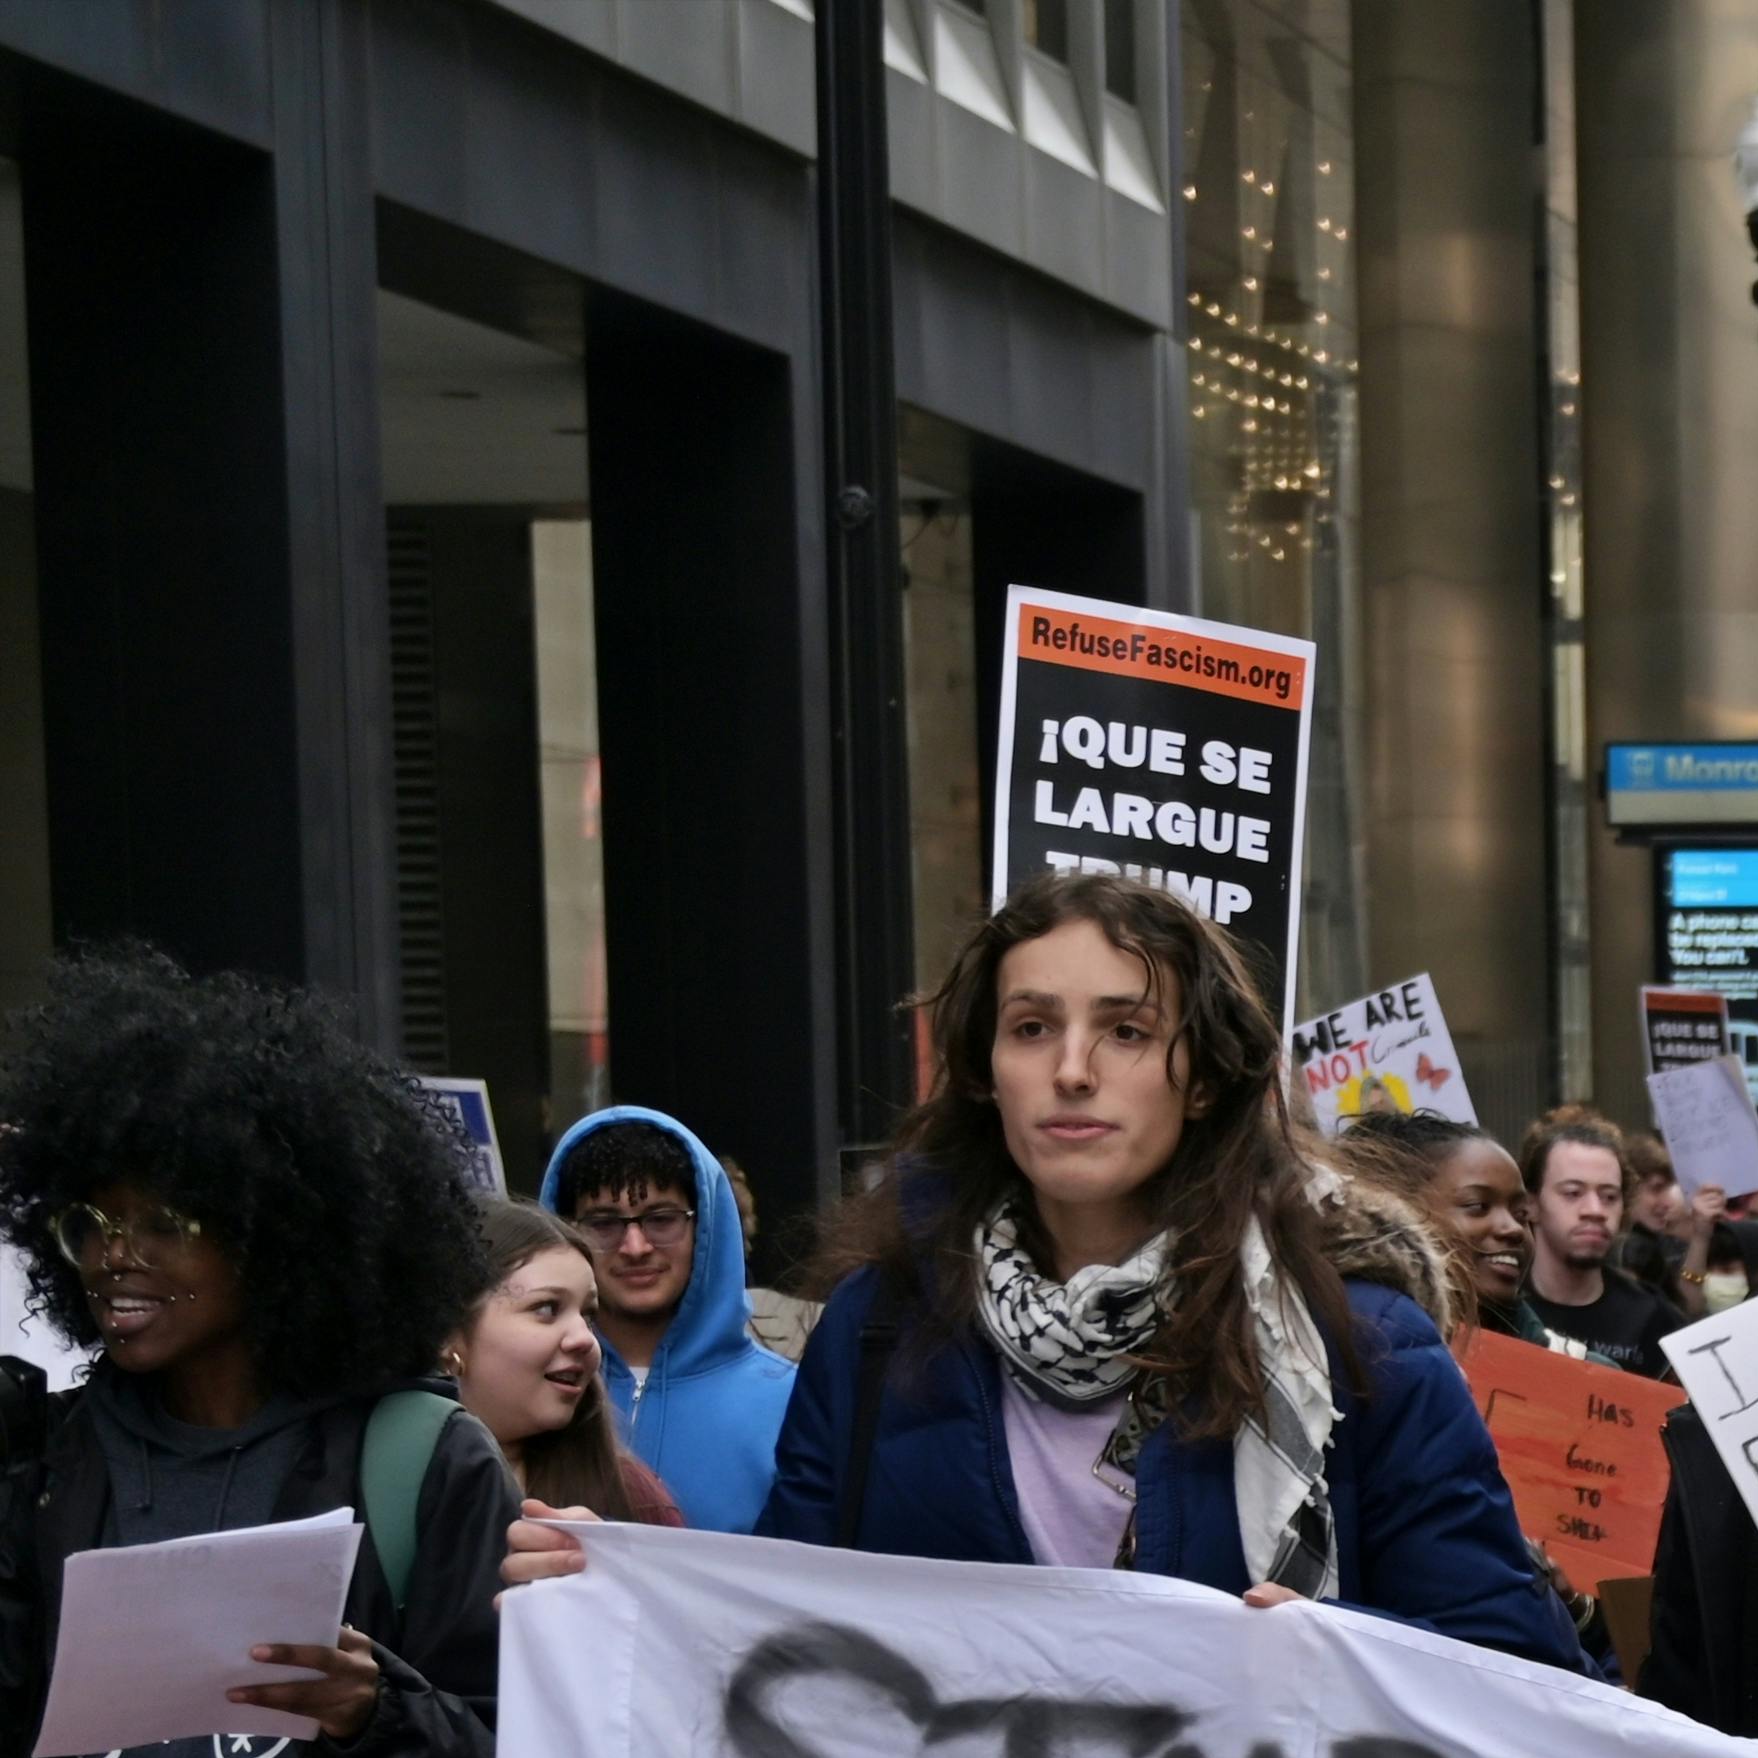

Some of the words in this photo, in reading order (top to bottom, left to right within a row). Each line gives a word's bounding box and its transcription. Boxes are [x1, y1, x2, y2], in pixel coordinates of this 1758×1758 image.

[1032, 615, 1292, 700] RefuseFascism.org
[1039, 715, 1187, 776] ¡QUE
[1199, 740, 1273, 795] SE
[1034, 779, 1271, 863] LARGUE
[1293, 1012, 1352, 1064] WE
[1366, 982, 1424, 1031] ARE
[1306, 1040, 1370, 1094] NOT
[1566, 1444, 1617, 1476] Gone
[1575, 1486, 1602, 1508] TO
